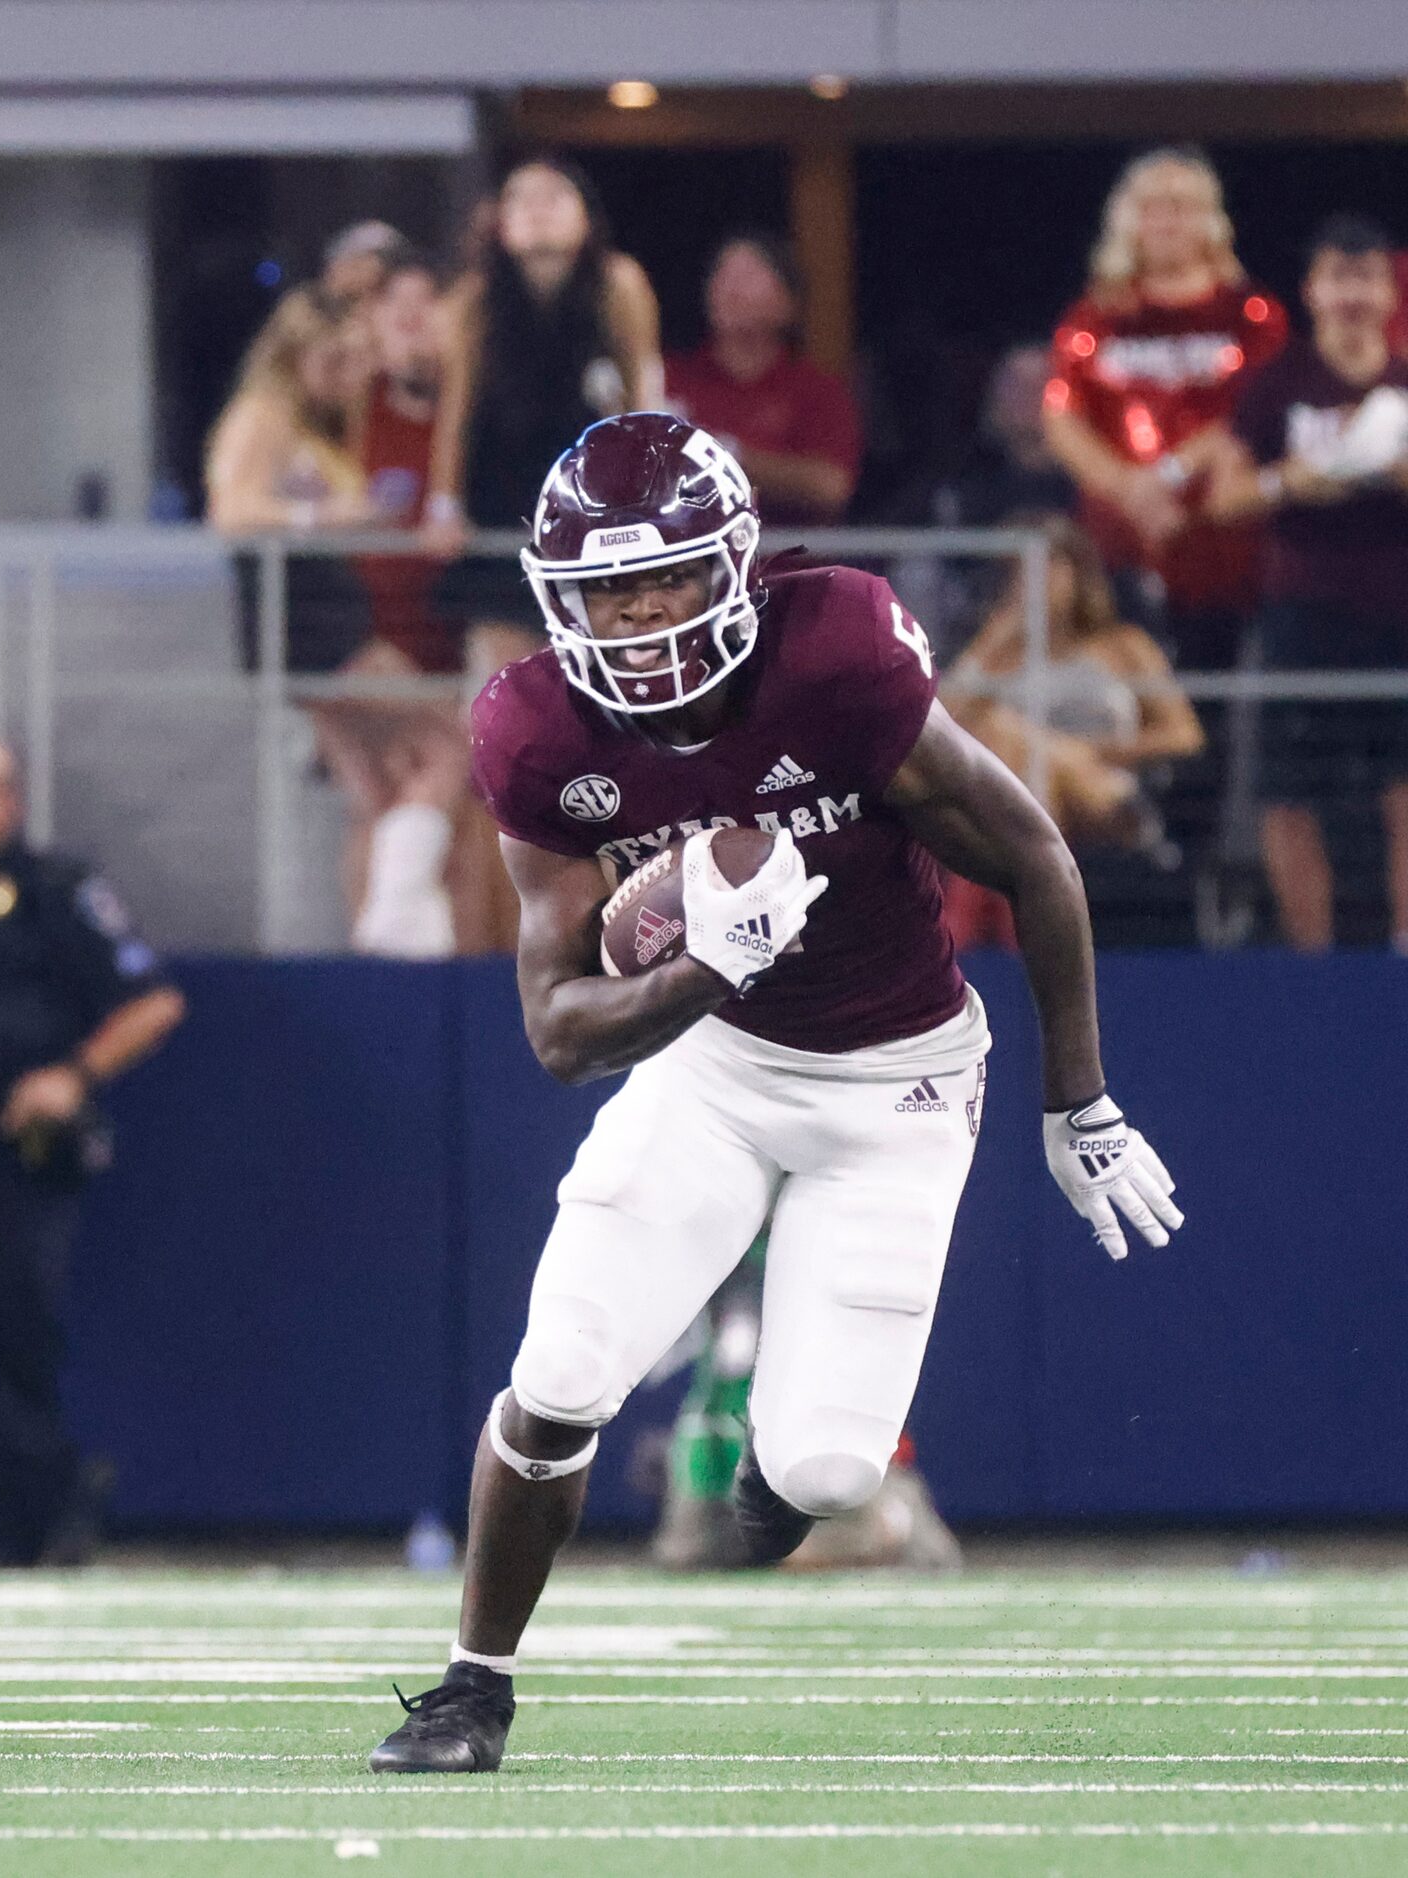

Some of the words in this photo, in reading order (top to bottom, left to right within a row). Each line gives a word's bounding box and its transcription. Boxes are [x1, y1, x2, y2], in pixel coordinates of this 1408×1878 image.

[599, 530, 641, 547] AGGIES
[756, 770, 816, 794] adidas
[565, 779, 616, 819] SEC
[755, 793, 862, 838] A&M
[637, 919, 685, 965] adidas
[895, 1101, 949, 1112] adidas
[1068, 1138, 1128, 1153] adidas
